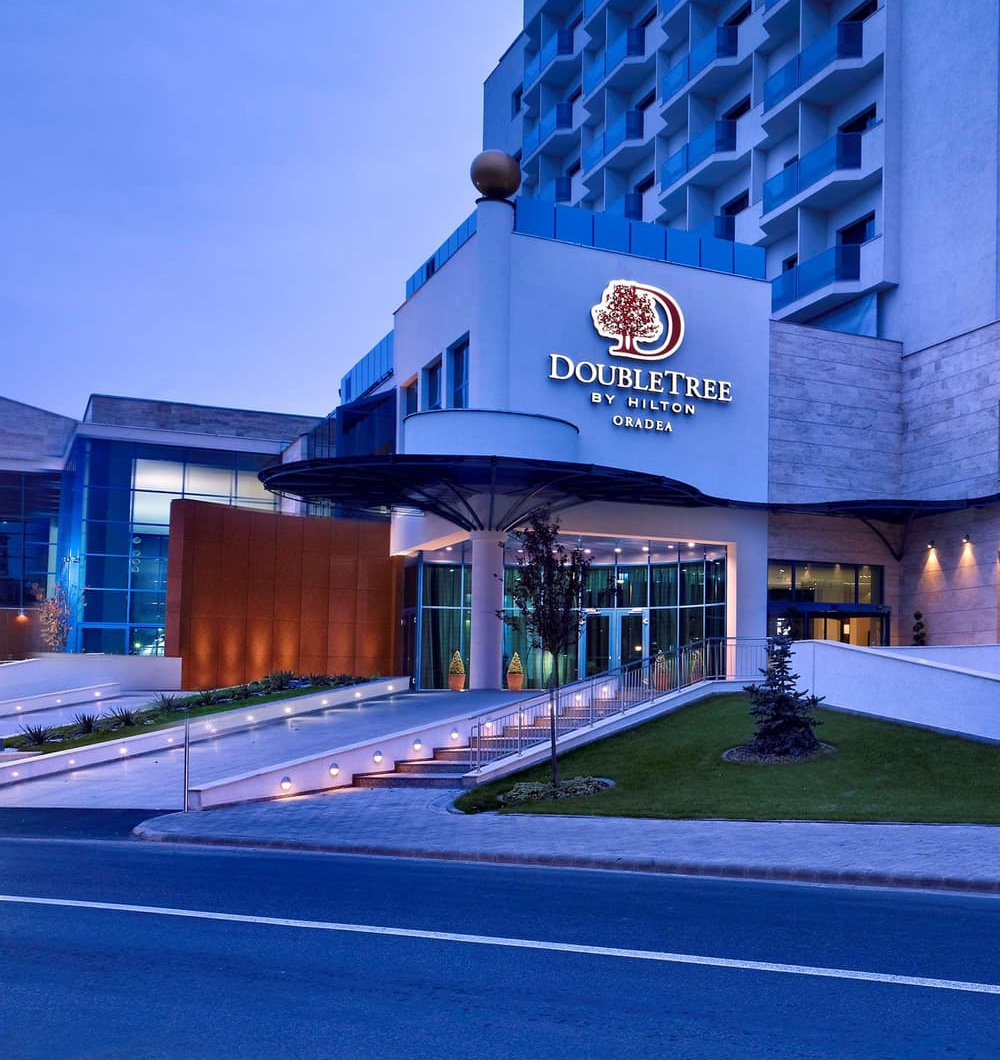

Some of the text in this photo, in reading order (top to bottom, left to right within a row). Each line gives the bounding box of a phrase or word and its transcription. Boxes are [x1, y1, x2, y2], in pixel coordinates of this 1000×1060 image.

[549, 353, 733, 403] DOUBLETREE
[591, 392, 695, 415] BY HILTON
[612, 415, 673, 432] ORADEA
